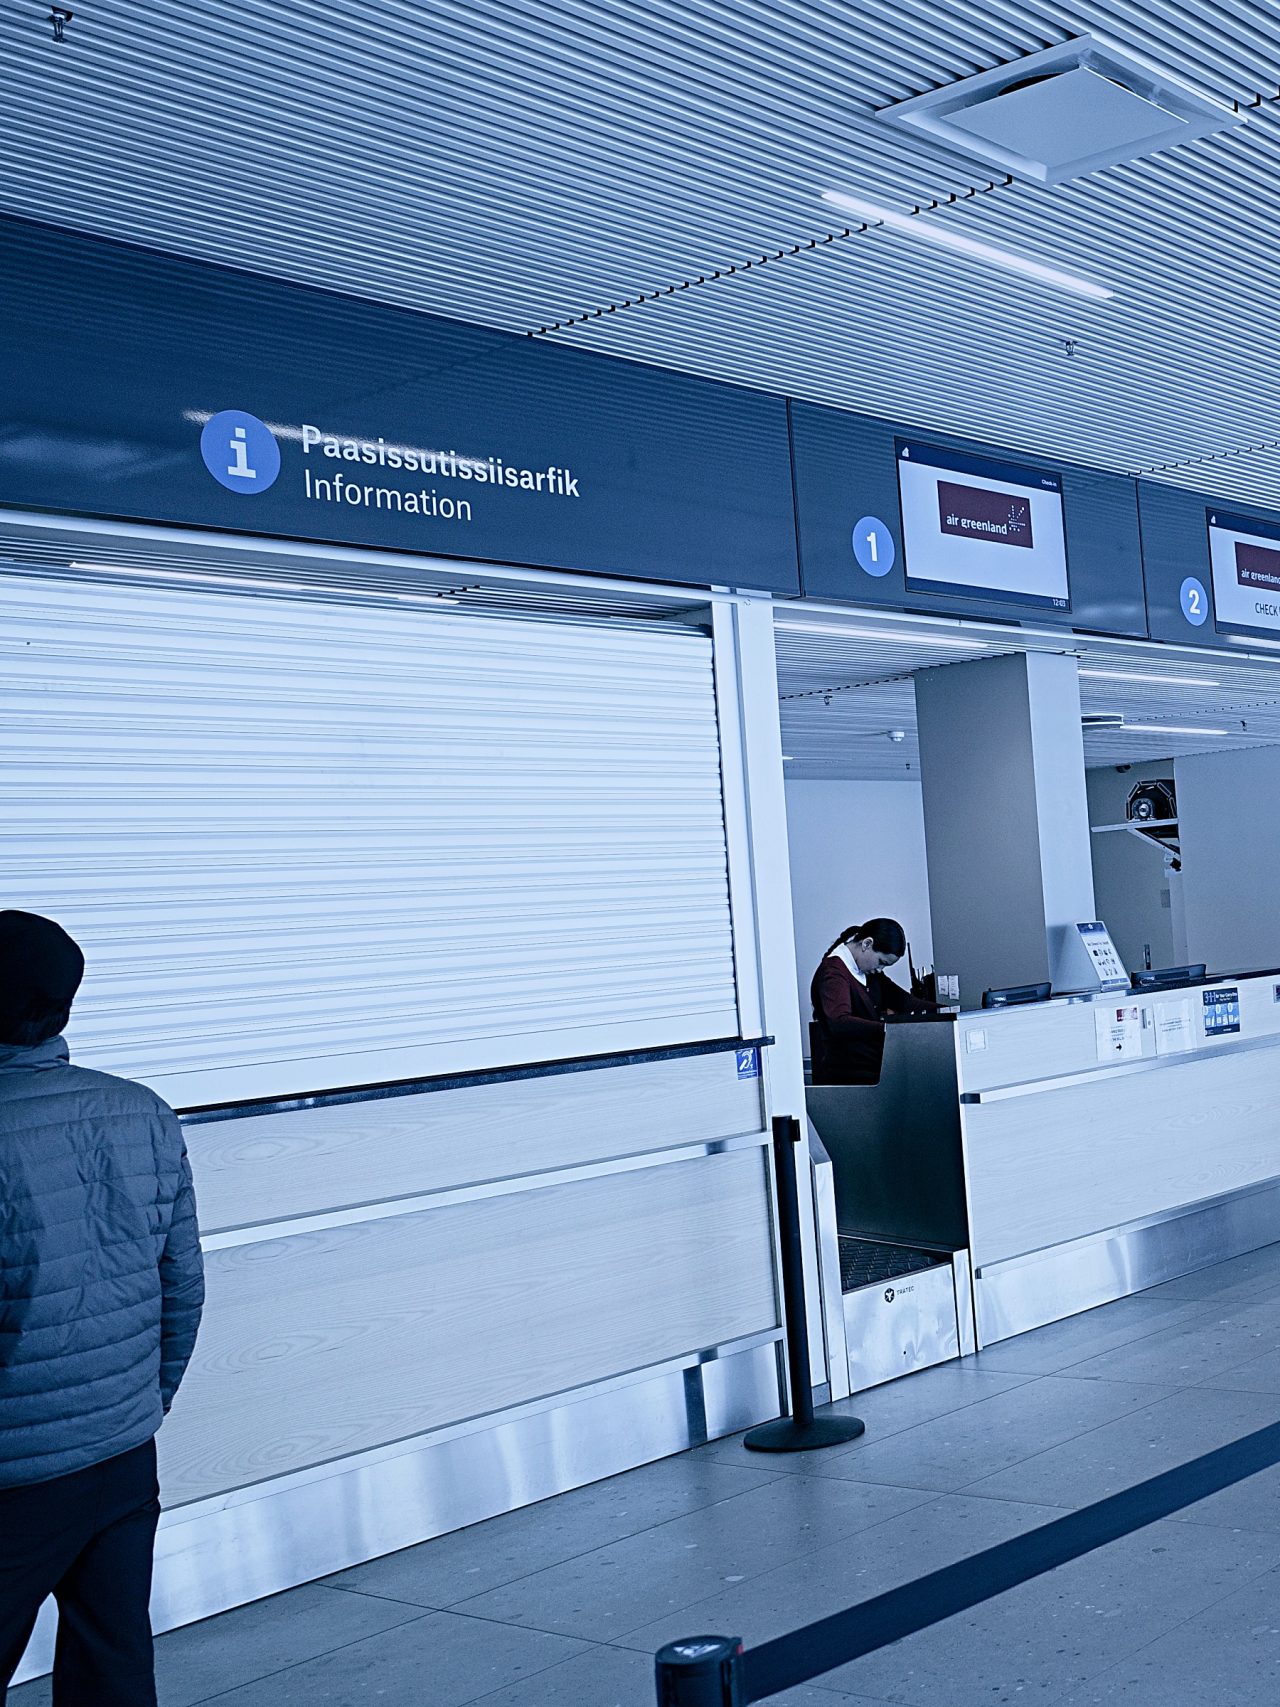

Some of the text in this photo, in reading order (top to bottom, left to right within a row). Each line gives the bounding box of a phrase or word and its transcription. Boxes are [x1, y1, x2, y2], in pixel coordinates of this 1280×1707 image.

[302, 424, 581, 498] Paasissutissiisarfik
[305, 468, 472, 521] Information
[946, 513, 1008, 535] air greenland
[866, 531, 878, 562] 1
[1241, 568, 1250, 579] air
[1188, 589, 1201, 615] 2
[1255, 602, 1278, 617] CHECK
